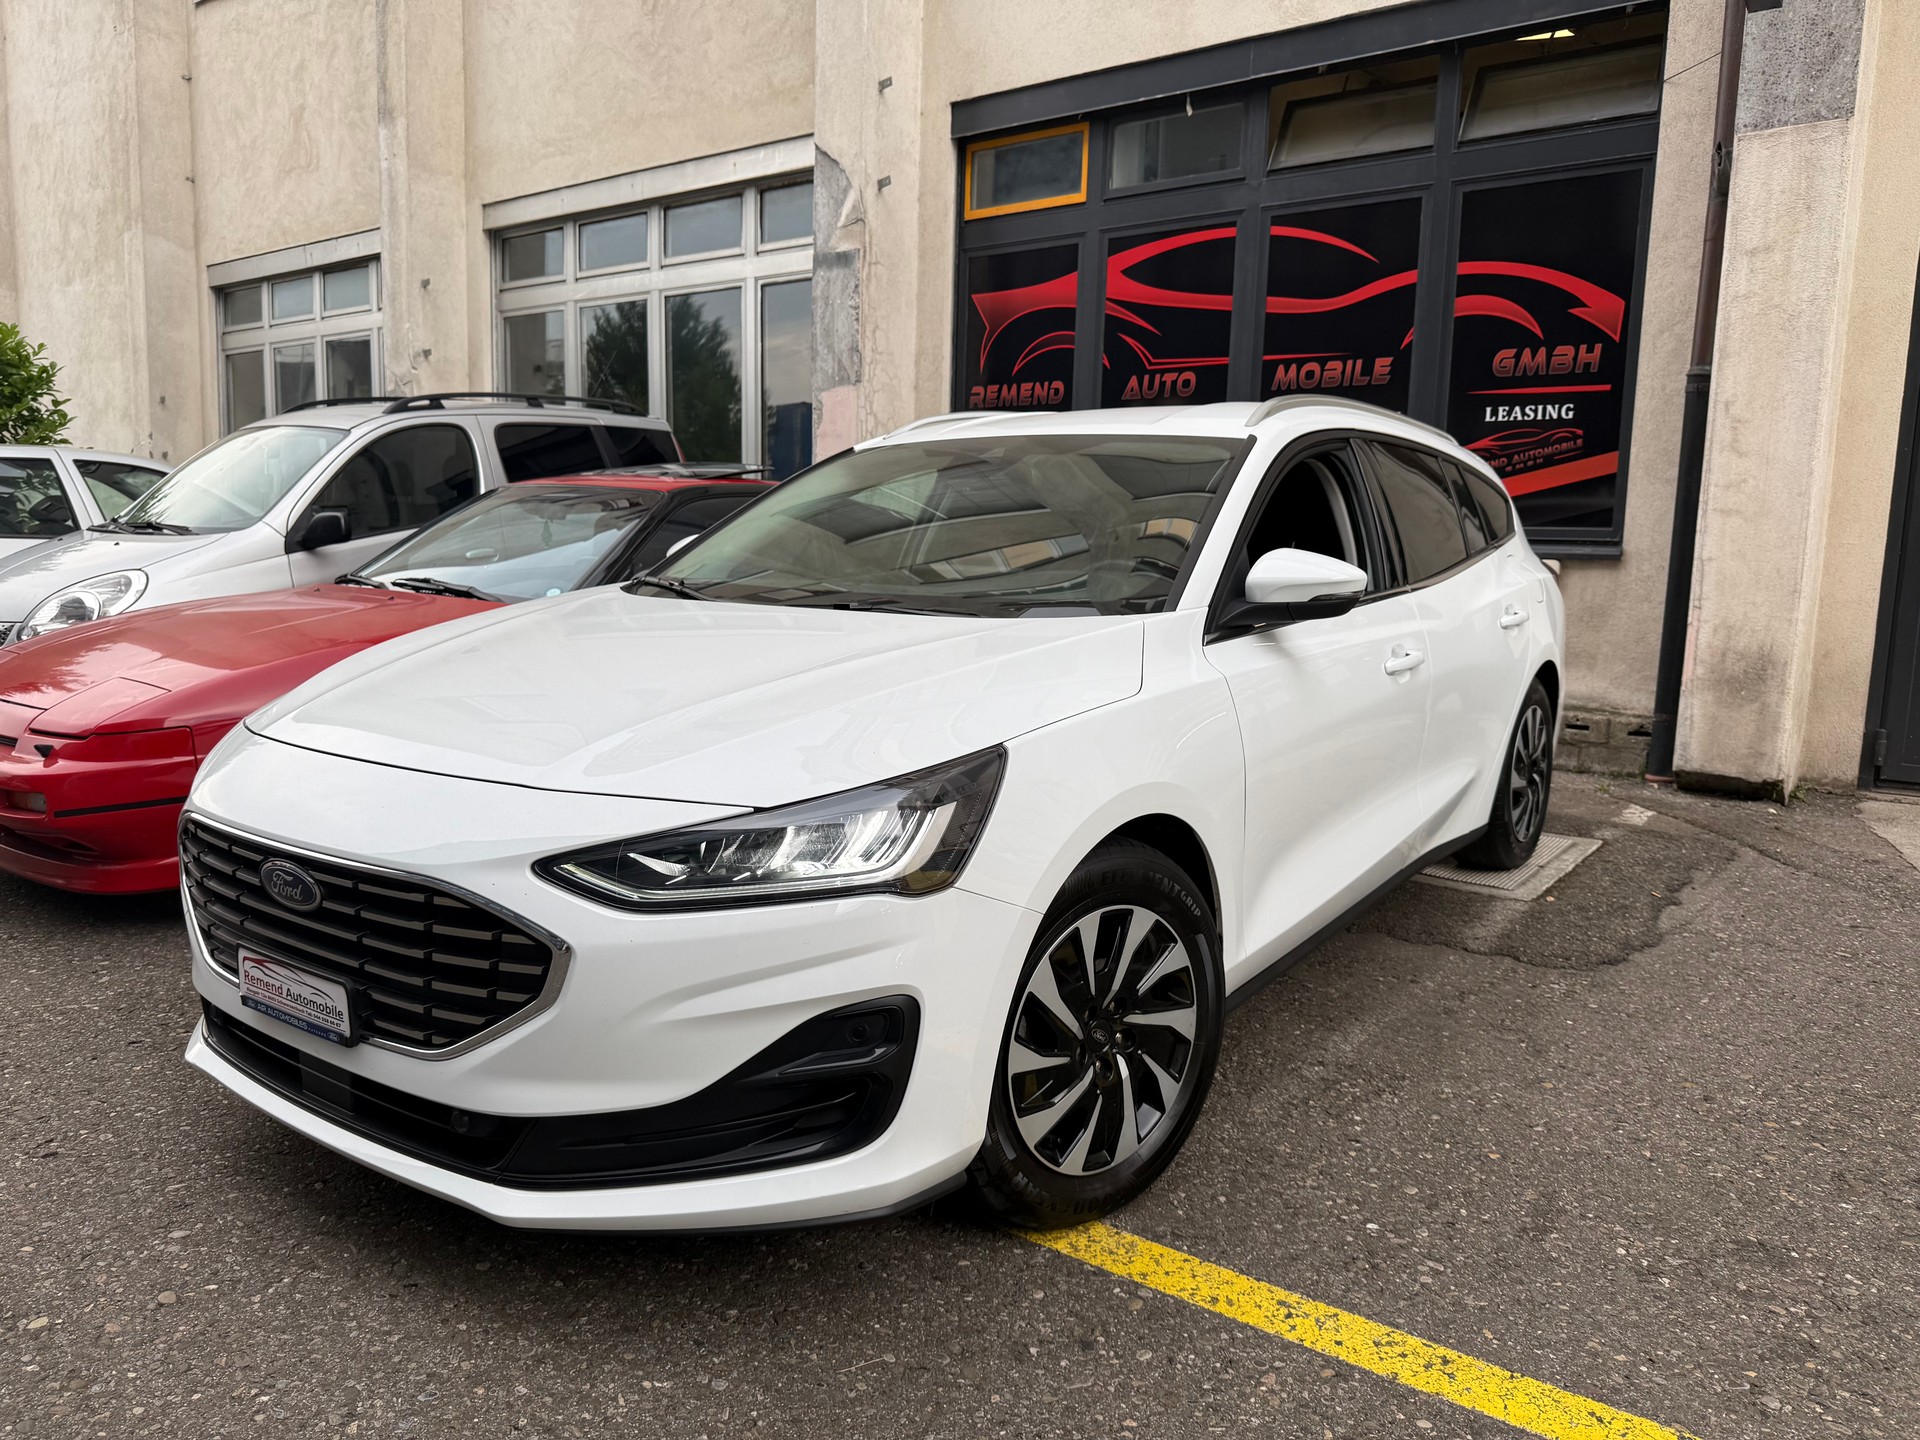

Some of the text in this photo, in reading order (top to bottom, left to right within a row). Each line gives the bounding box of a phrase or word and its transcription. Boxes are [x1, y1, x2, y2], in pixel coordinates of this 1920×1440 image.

[969, 343, 1603, 409] REMEND AUTO MOBILE GMBH
[1484, 404, 1576, 422] LEASING
[1512, 439, 1584, 463] AUTOMOBILE
[271, 870, 304, 901] Ford
[244, 969, 345, 1020] Remend Automobile
[267, 1006, 308, 1030] AUTOMOBILES
